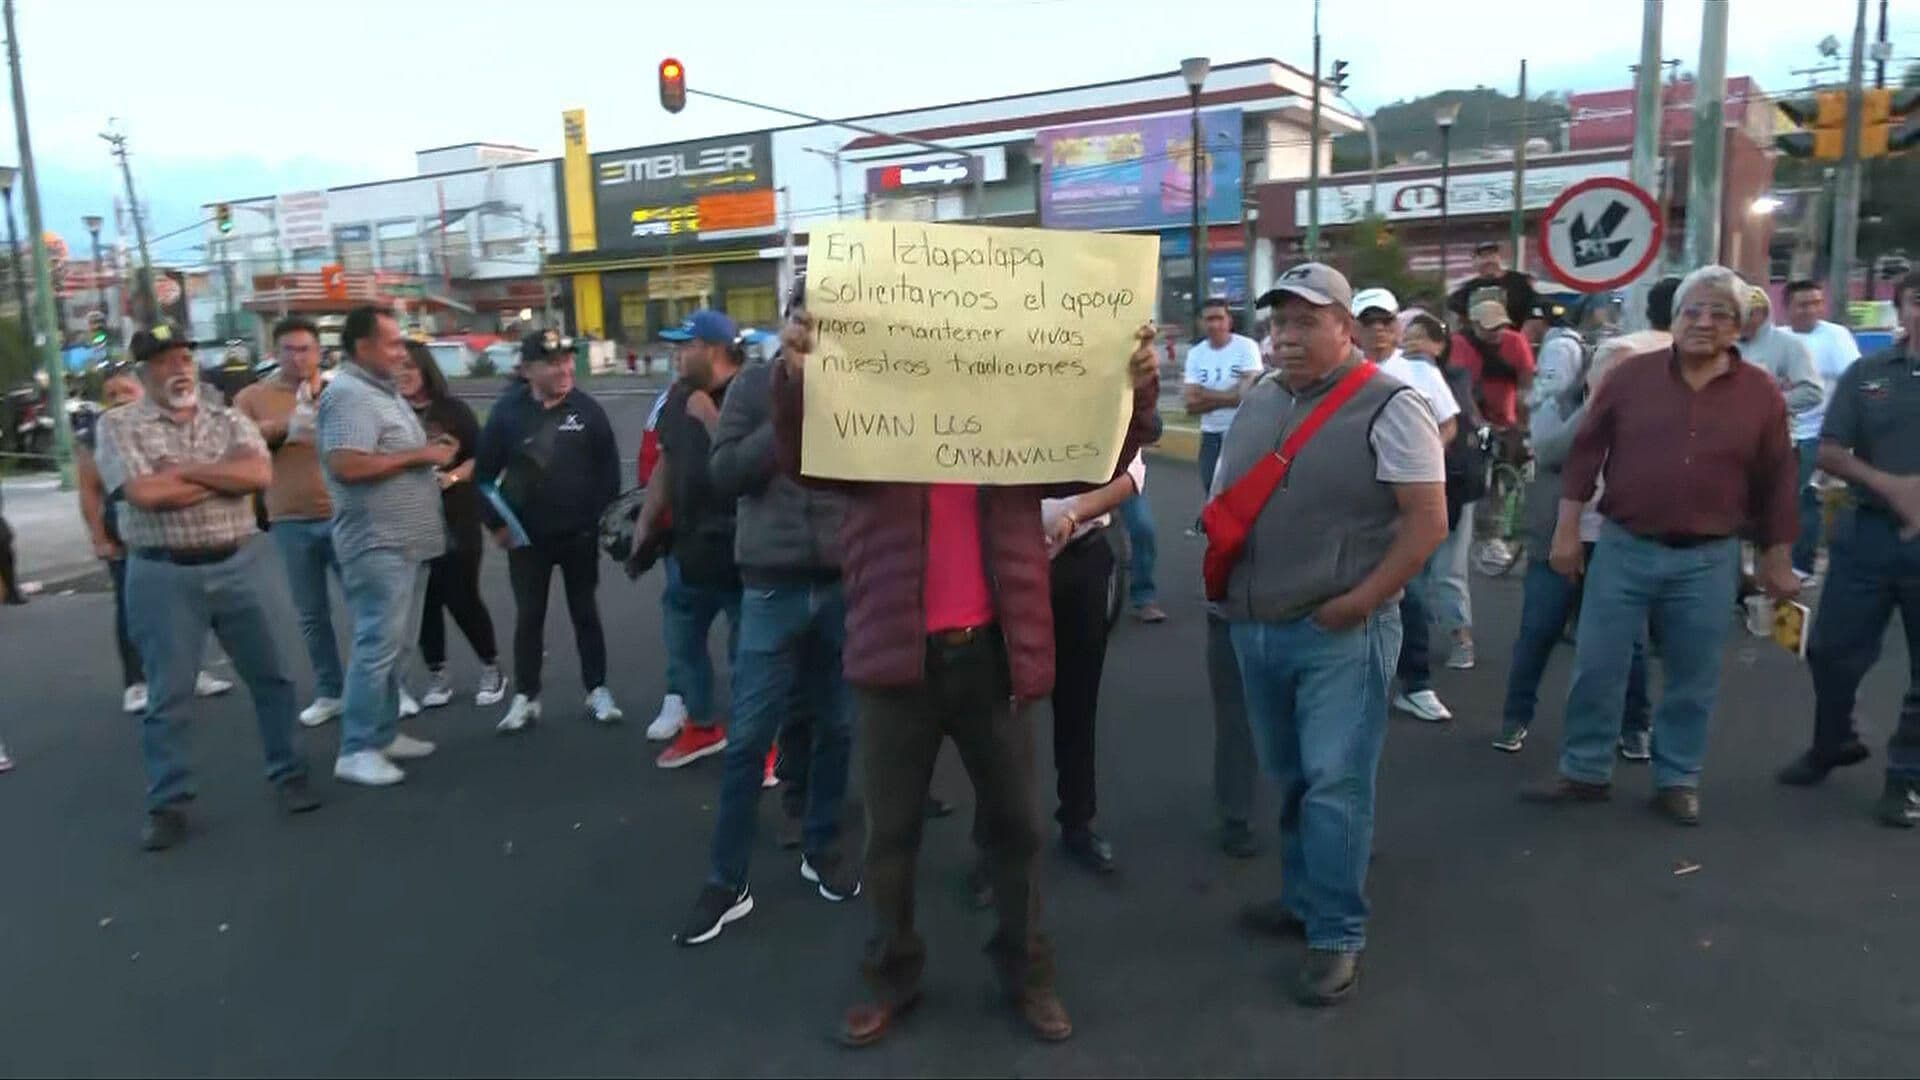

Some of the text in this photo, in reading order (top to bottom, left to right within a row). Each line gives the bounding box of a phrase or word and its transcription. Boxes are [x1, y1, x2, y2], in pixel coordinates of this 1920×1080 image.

[600, 143, 754, 185] EMBLER
[826, 227, 1045, 278] En Iztapalapa
[1023, 281, 1046, 311] el
[1060, 286, 1135, 319] apoyo
[816, 317, 1085, 347] para mantener vivas
[946, 353, 1087, 377] tradiciones
[833, 411, 916, 440] VIVAN
[935, 444, 1101, 469] CARNAVALES
